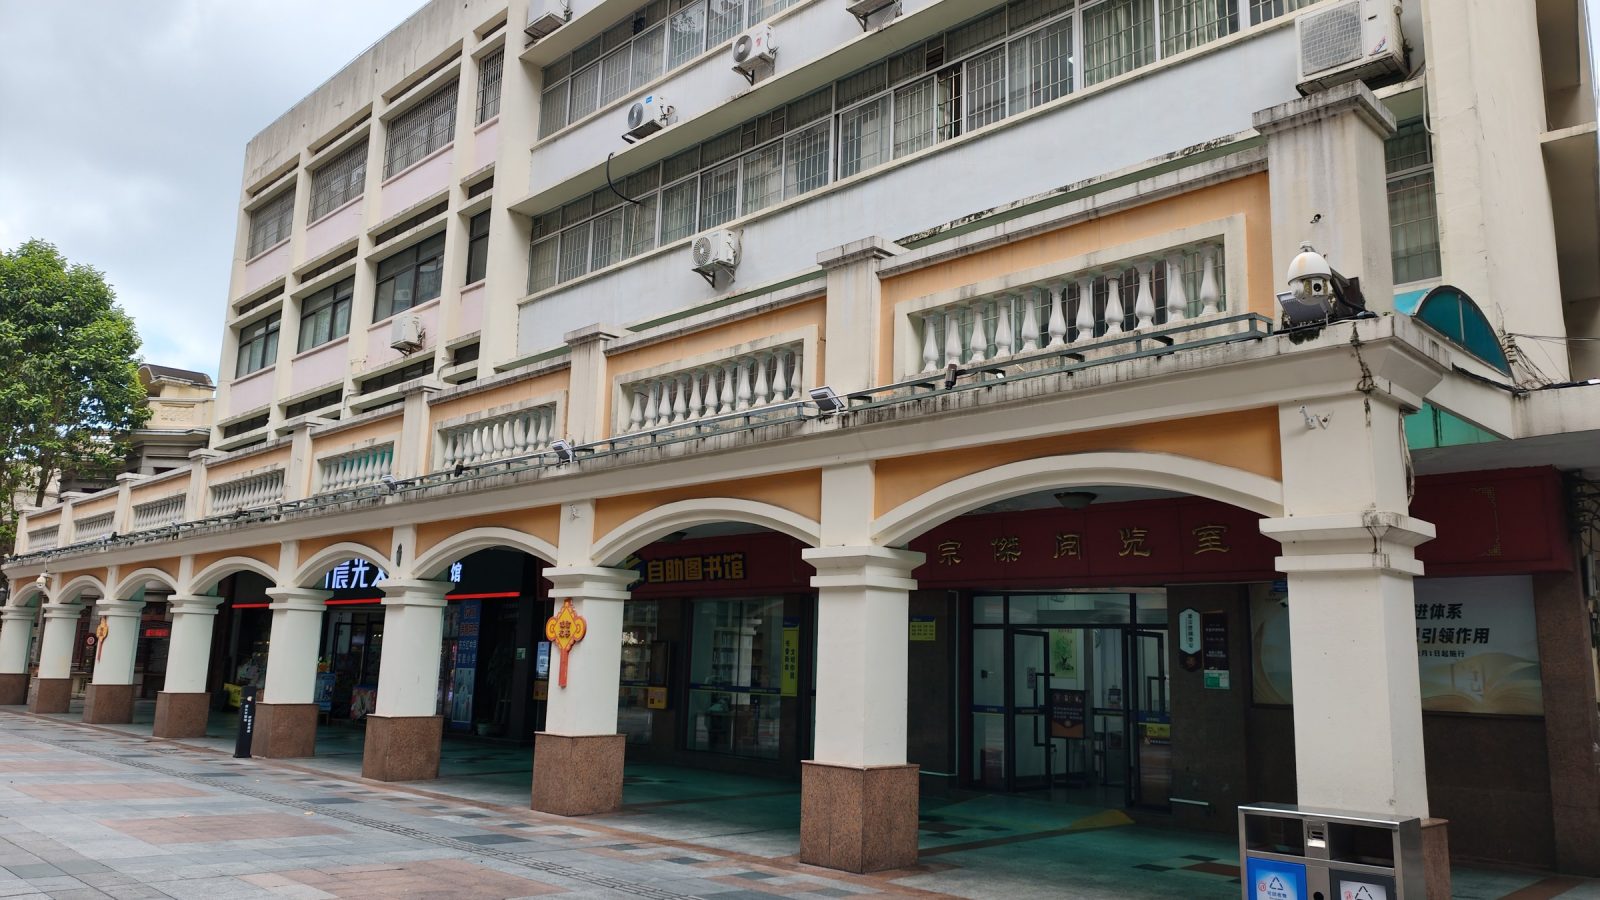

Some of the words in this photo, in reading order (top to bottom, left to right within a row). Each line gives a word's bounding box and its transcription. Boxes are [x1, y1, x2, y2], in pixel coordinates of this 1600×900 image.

[647, 553, 744, 583] 自助图书馆
[1417, 627, 1490, 644] 引领作用
